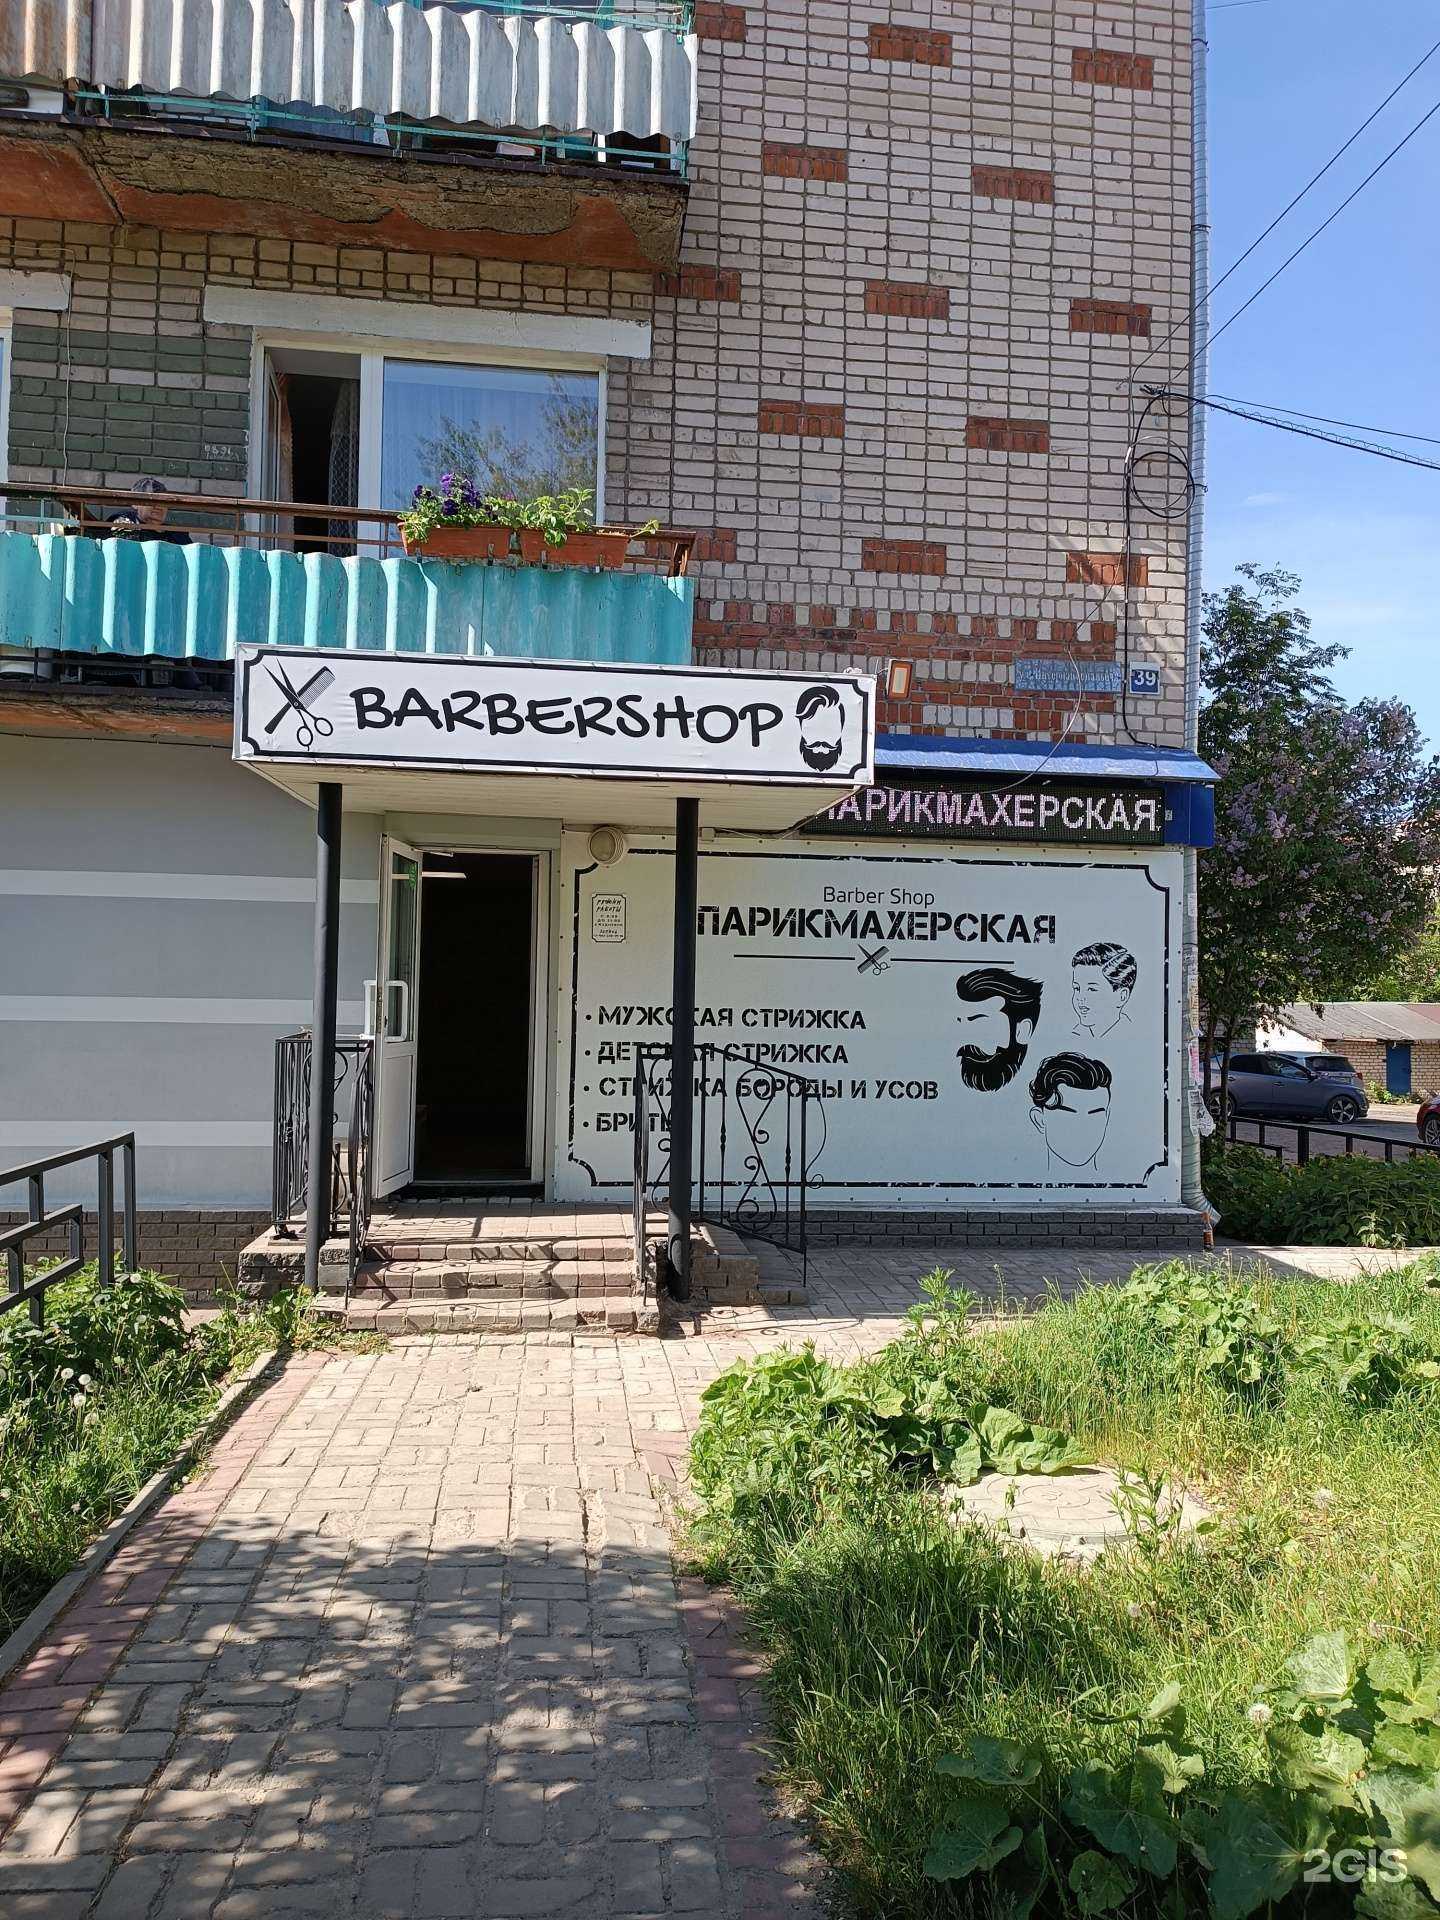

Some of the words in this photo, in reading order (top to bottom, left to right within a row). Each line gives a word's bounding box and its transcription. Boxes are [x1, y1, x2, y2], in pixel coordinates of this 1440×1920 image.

[1134, 669, 1156, 686] 39
[349, 686, 783, 747] BARBERSHOP
[823, 886, 885, 904] Barber
[890, 888, 935, 909] Shop
[697, 905, 1056, 944] ПАРИКМАХЕРСКАЯ
[741, 1008, 866, 1029] СТРИЖКА
[724, 1043, 849, 1064] СТРИЖКА
[736, 1078, 843, 1101] БОРОДЫ
[851, 1080, 867, 1099] И
[875, 1080, 939, 1099] УСОВ
